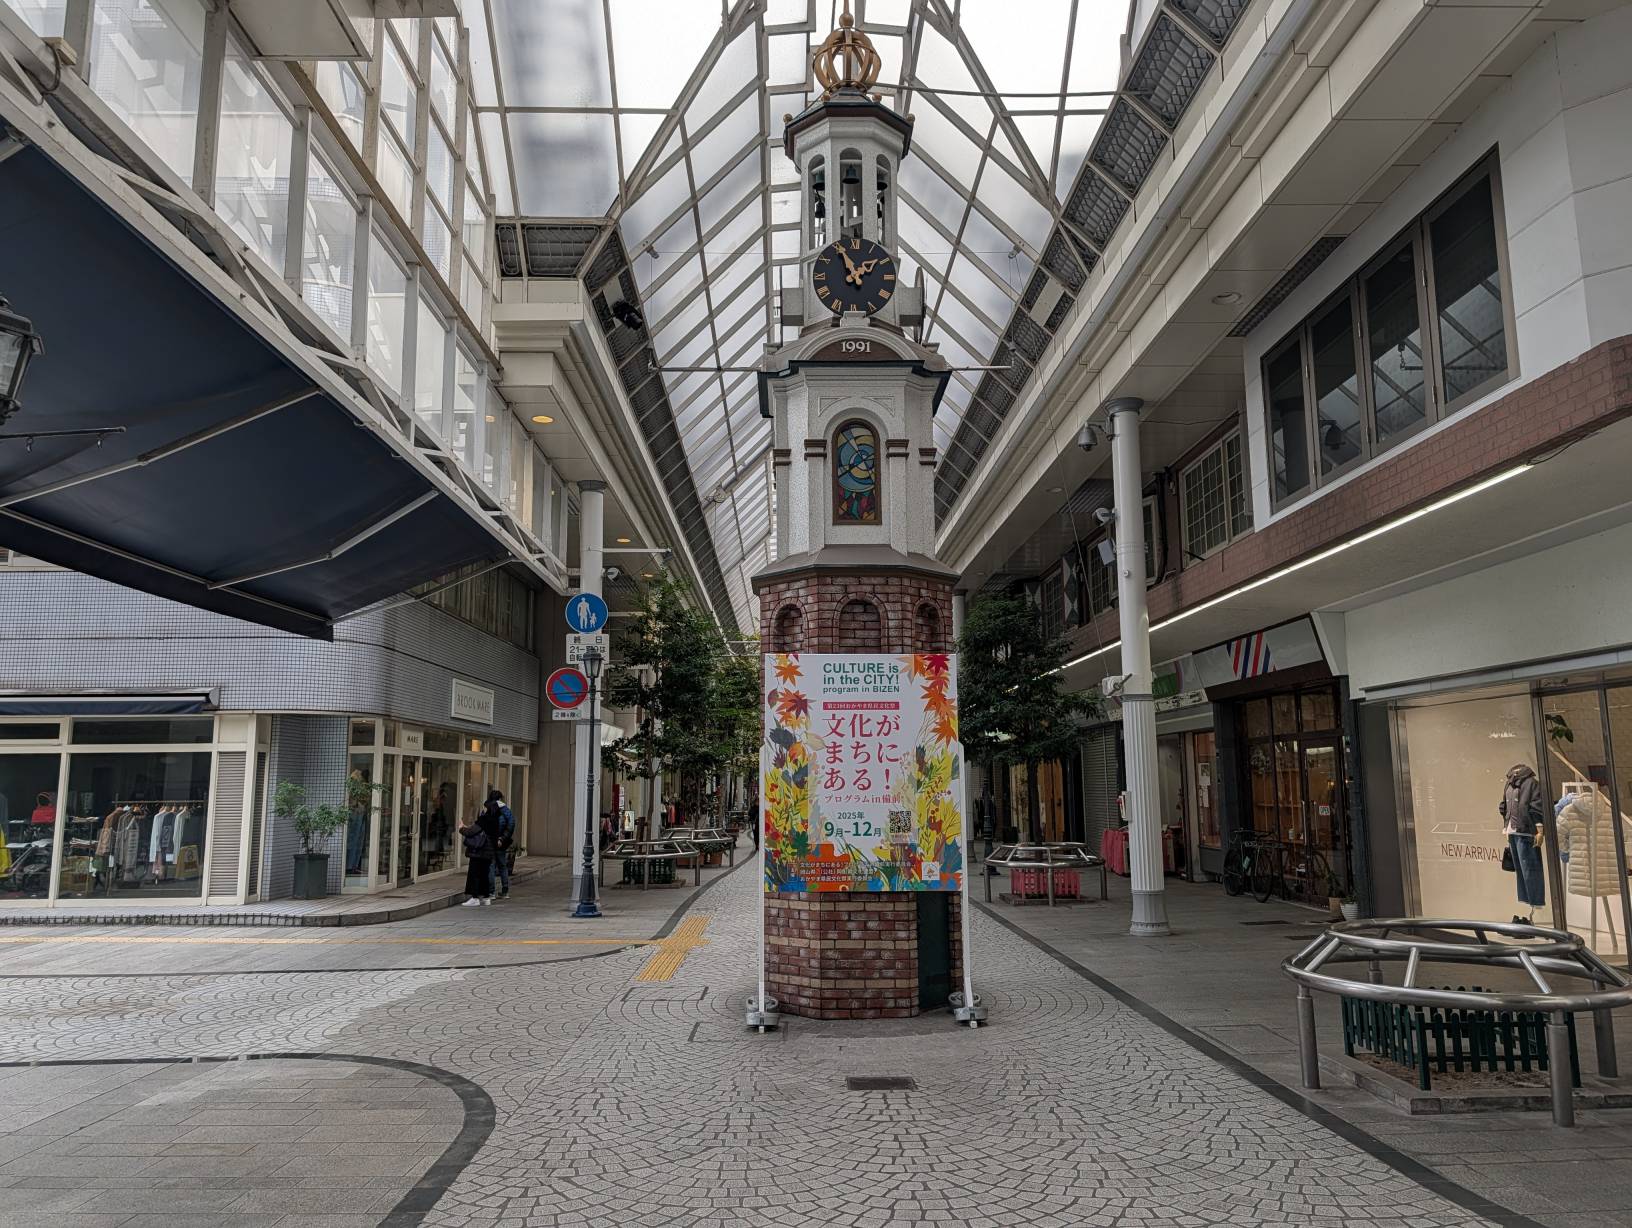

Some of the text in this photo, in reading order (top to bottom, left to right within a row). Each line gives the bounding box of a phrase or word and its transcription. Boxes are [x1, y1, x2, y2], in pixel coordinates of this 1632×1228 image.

[841, 341, 871, 353] 1991
[823, 663, 899, 673] CULTURE is
[823, 674, 899, 685] in the CITY!
[823, 686, 859, 694] program
[822, 713, 900, 738] 文化が
[825, 741, 900, 764] まちに
[824, 768, 890, 791] ある！
[837, 811, 865, 820] 2025年
[1441, 843, 1503, 862] NEW ARRIVAL
